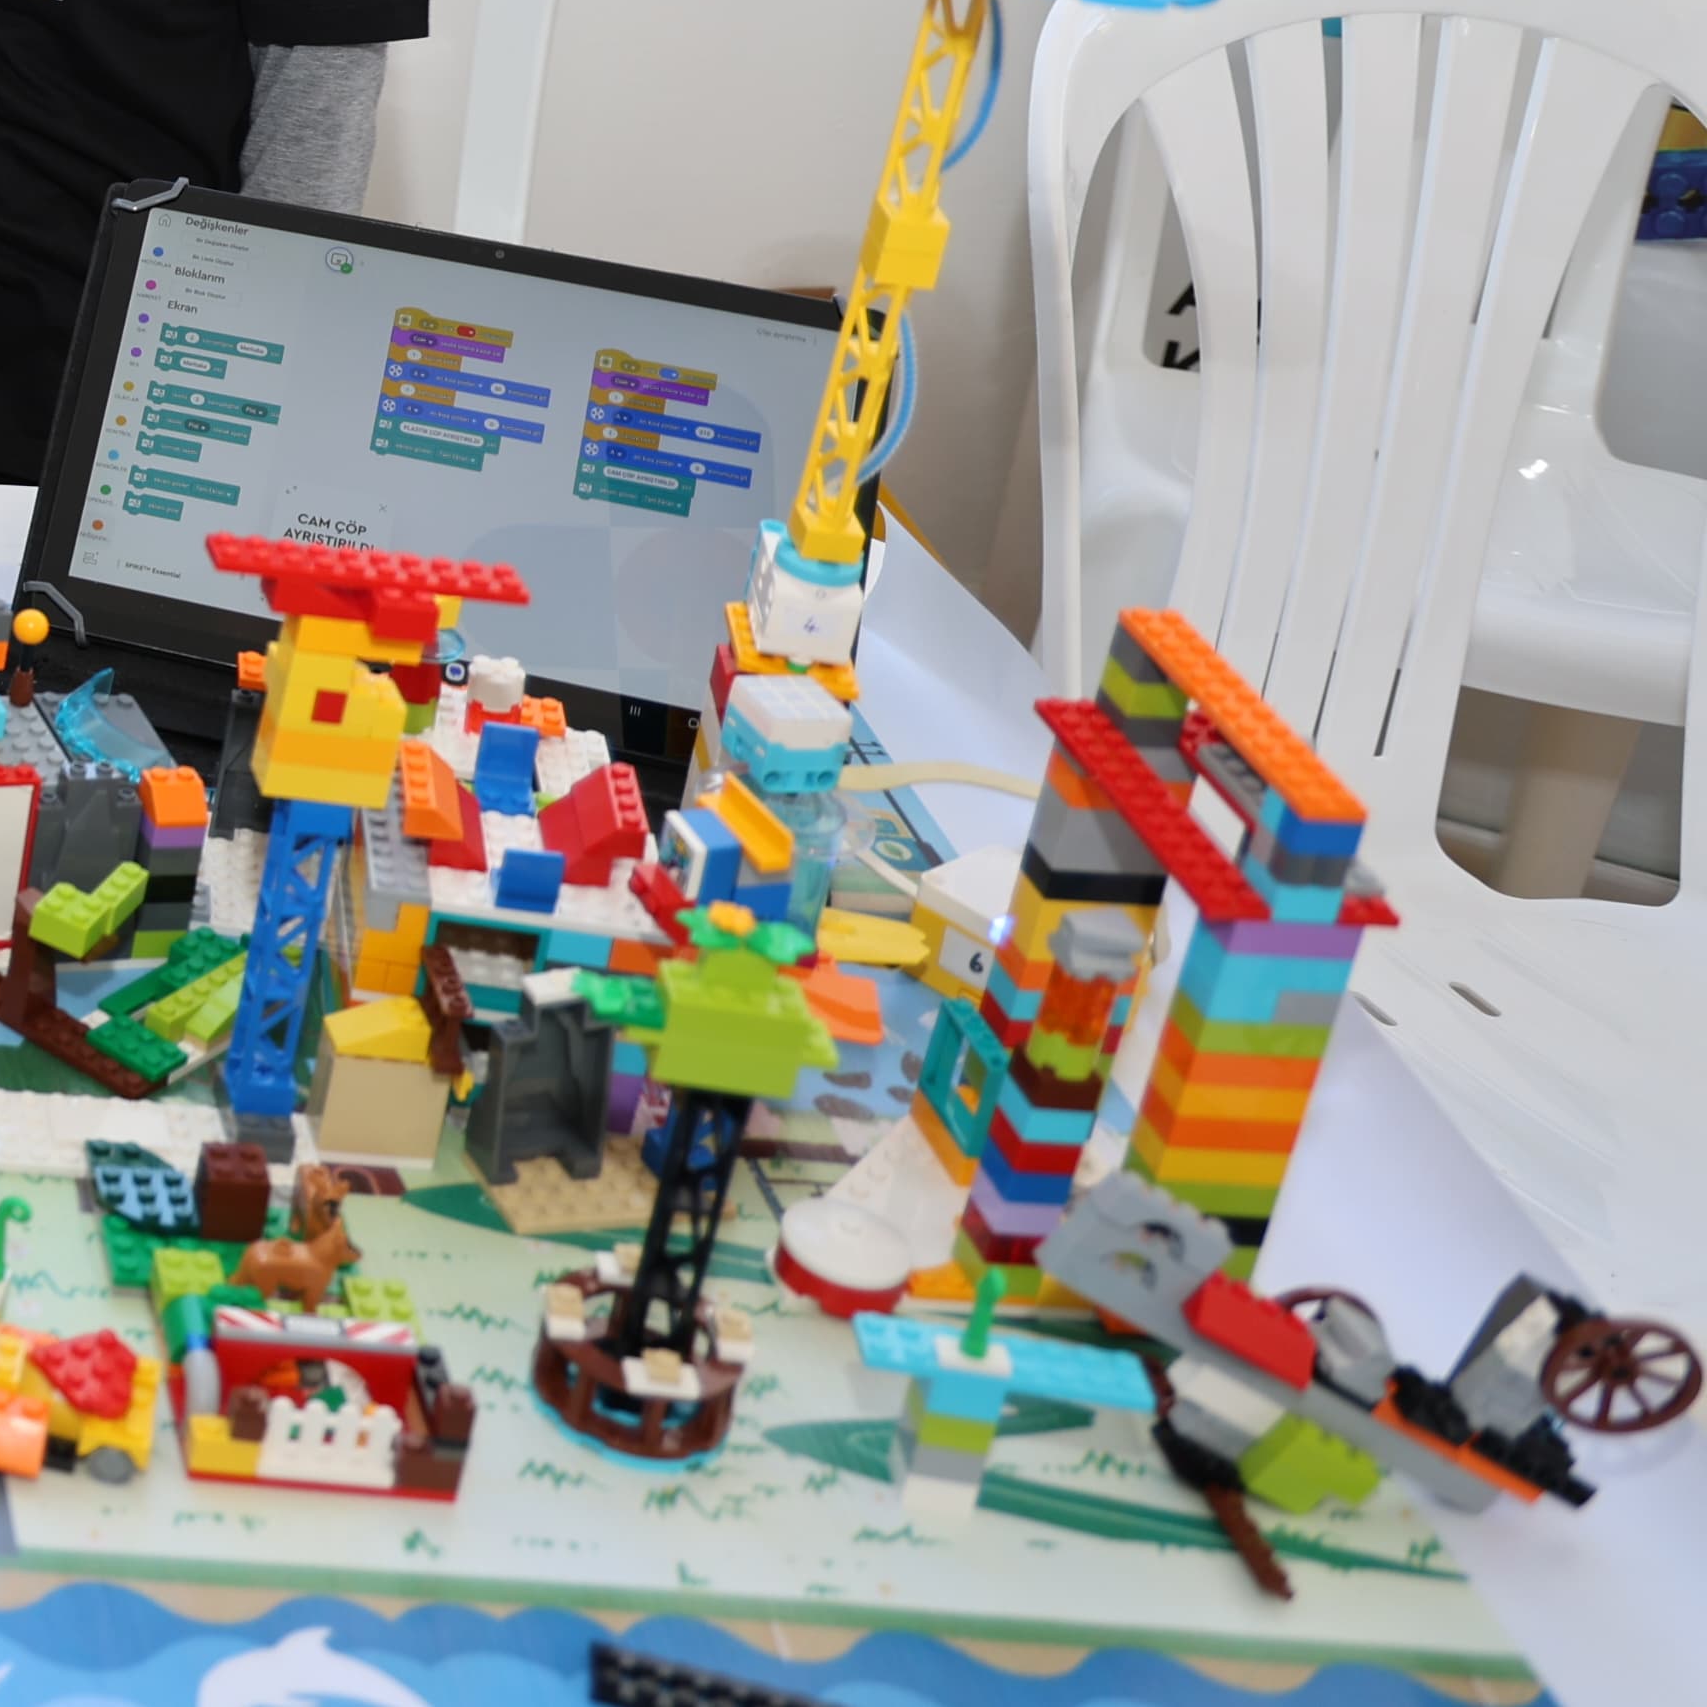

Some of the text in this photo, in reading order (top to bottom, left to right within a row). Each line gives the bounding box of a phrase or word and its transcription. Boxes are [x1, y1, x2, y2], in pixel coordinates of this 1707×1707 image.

[185, 216, 249, 236] Değişkenler
[175, 266, 225, 284] Bloklarım
[167, 299, 198, 314] Ekran
[297, 513, 367, 536] CAM ÇÖP
[969, 952, 984, 973] 6
